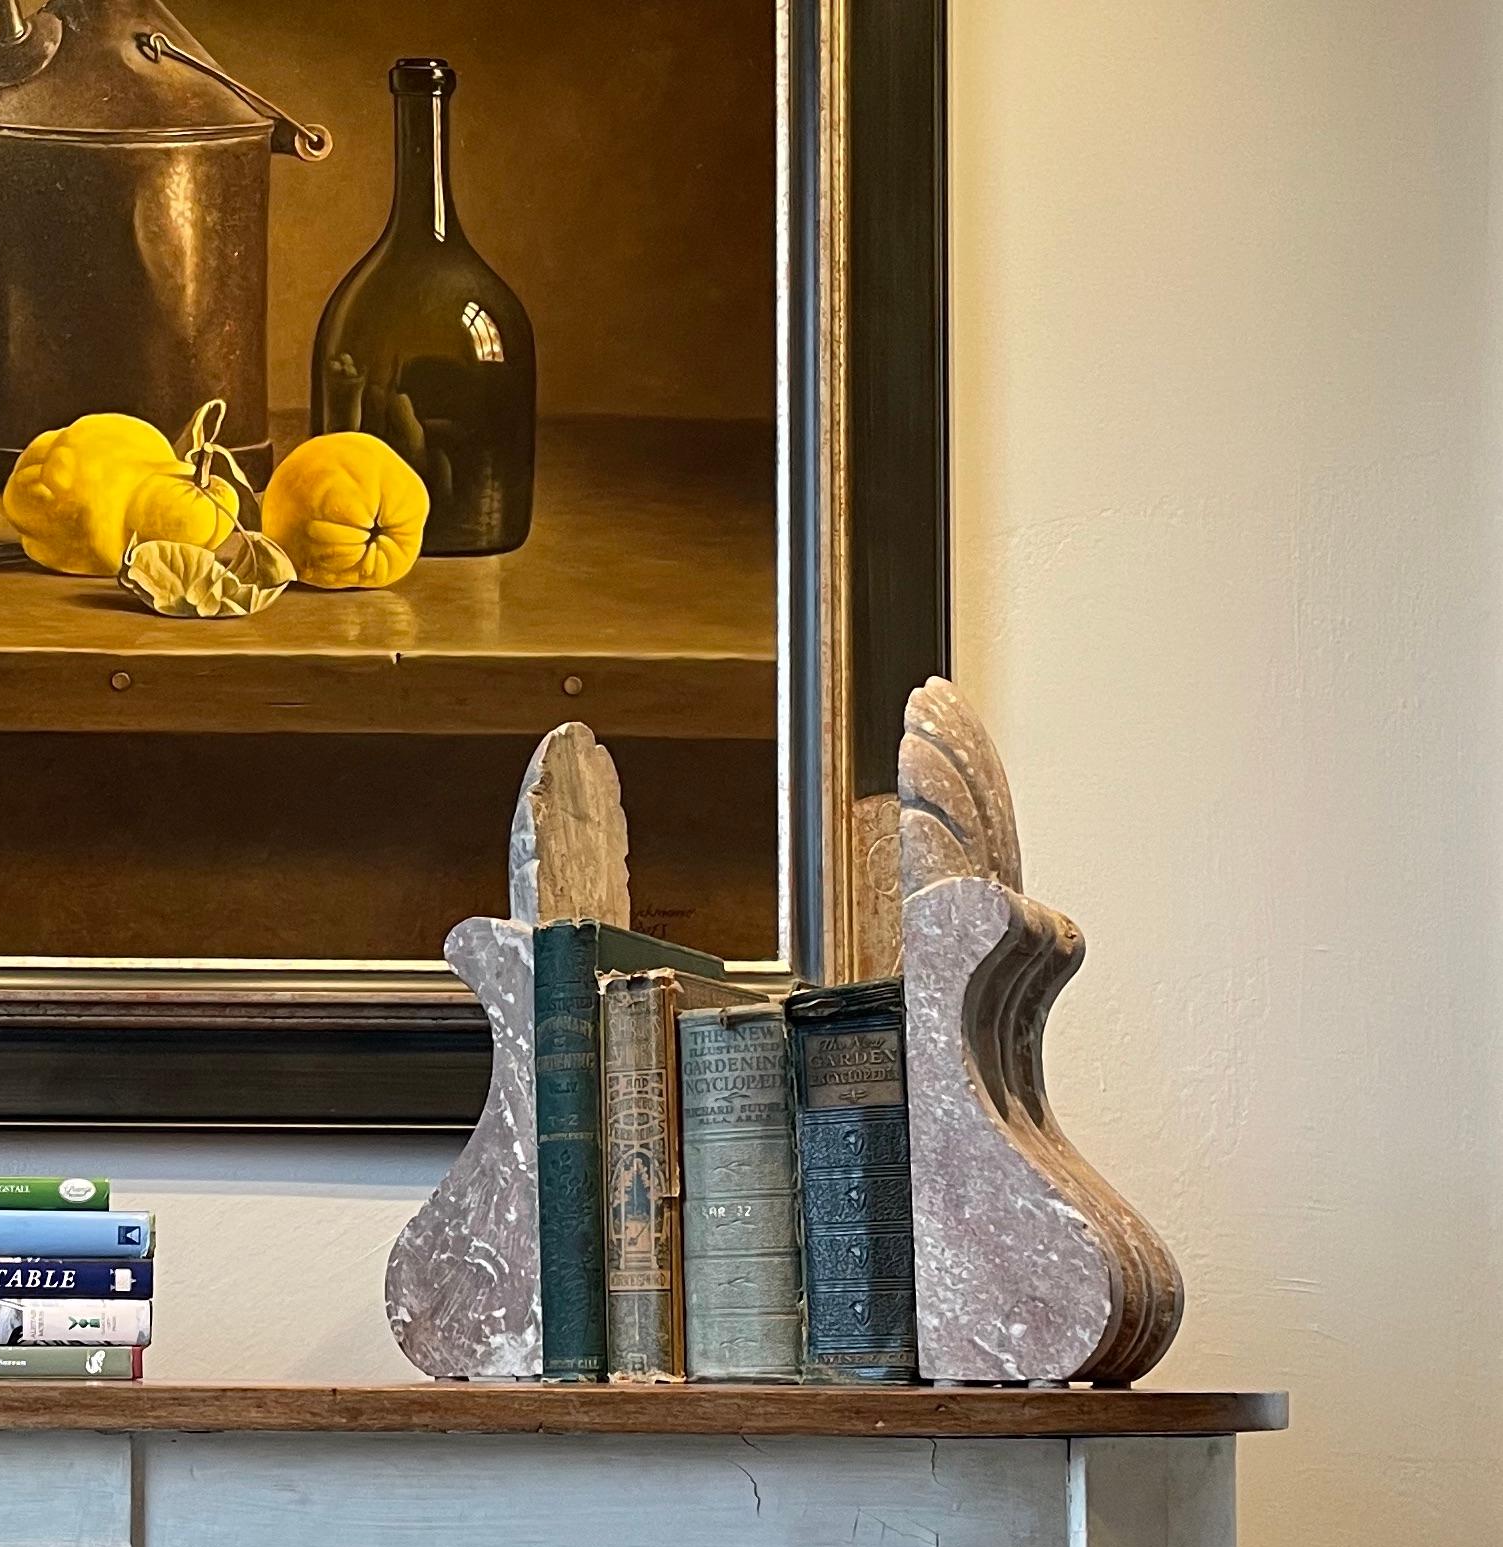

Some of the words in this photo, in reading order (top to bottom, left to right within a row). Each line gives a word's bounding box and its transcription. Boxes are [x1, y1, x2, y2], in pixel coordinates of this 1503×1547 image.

[690, 1029, 724, 1045] THE
[733, 1026, 778, 1042] NEW
[684, 1055, 789, 1076] GARDENING
[810, 1049, 896, 1069] GARDEN
